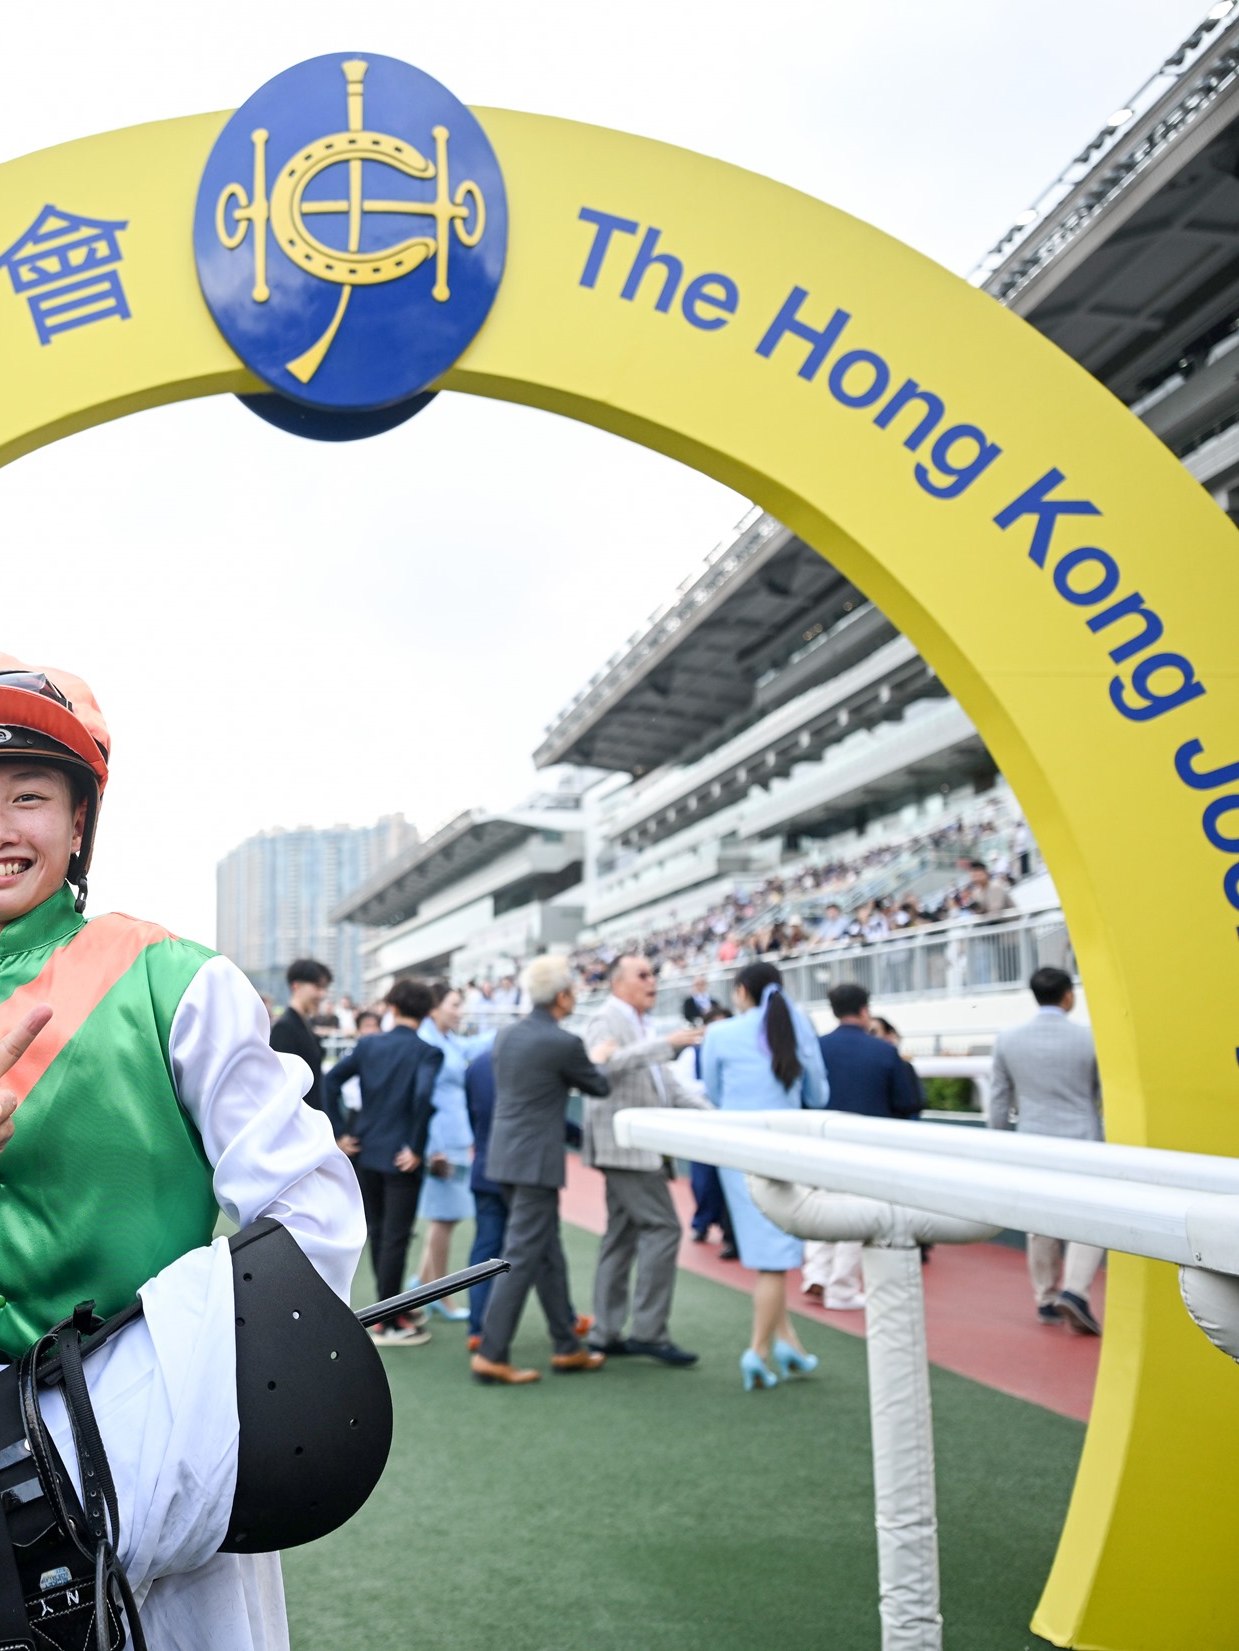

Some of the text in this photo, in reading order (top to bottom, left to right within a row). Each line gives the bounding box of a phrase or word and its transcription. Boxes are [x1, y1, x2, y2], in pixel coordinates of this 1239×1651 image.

[578, 206, 740, 331] The
[756, 286, 1002, 500] Hong
[993, 467, 1207, 723] Kong
